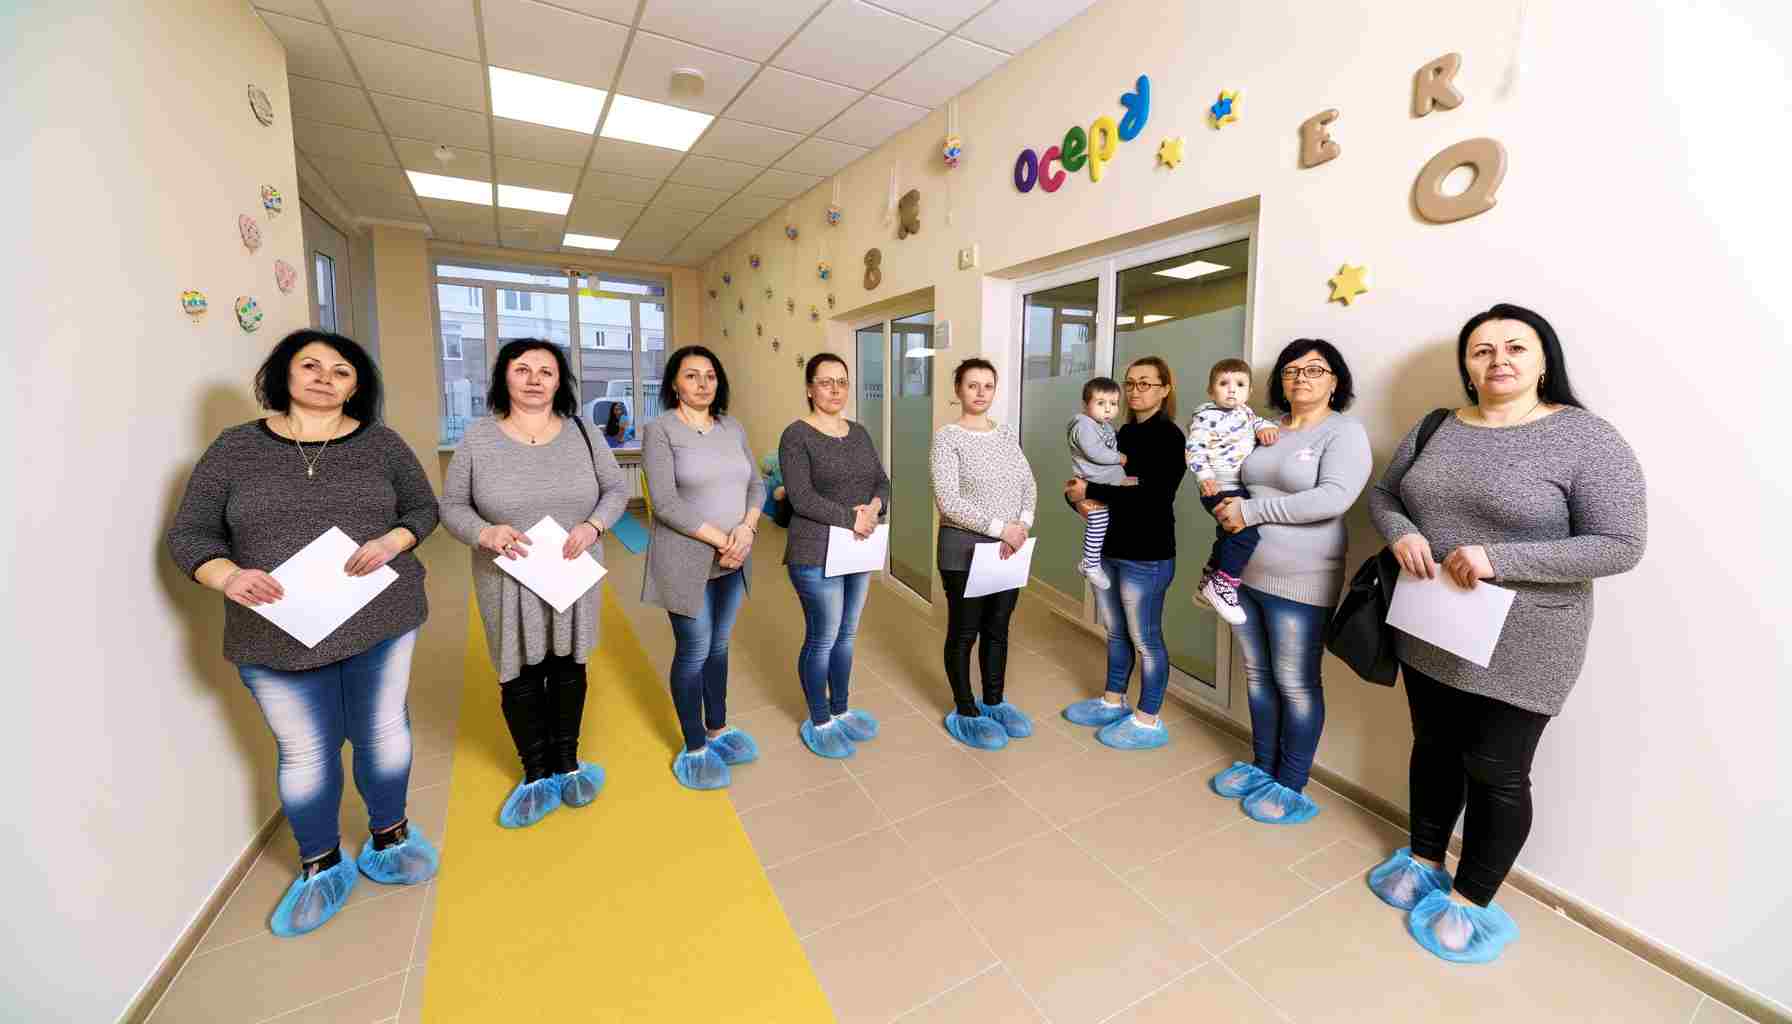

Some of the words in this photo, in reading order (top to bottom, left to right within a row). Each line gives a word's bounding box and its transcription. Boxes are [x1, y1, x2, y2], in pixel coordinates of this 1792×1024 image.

[1411, 53, 1464, 118] R
[1298, 109, 1341, 169] E
[1411, 138, 1507, 224] Q
